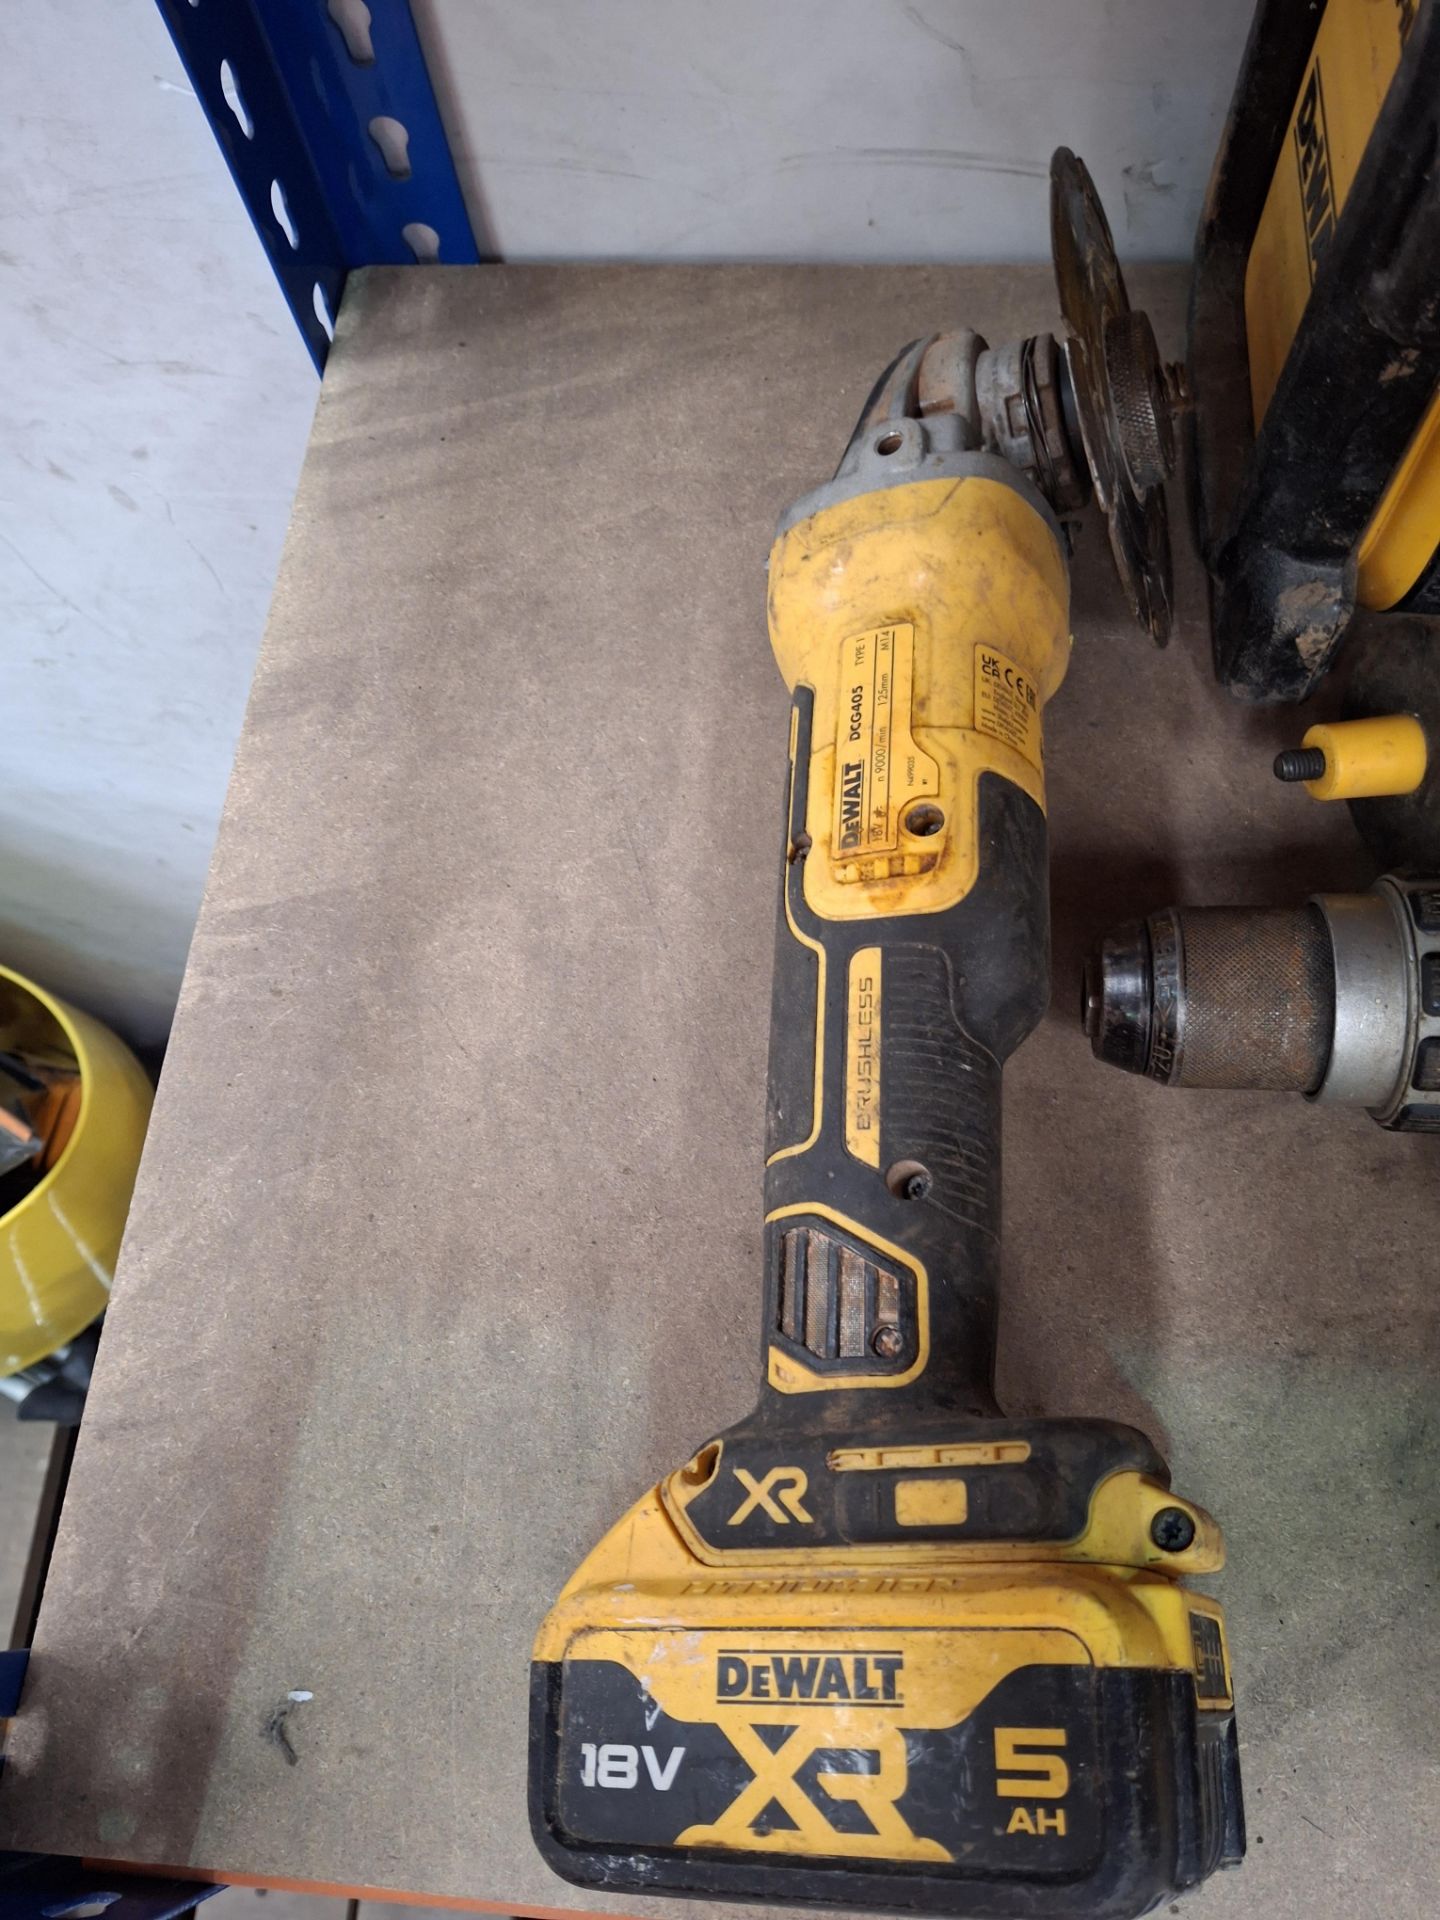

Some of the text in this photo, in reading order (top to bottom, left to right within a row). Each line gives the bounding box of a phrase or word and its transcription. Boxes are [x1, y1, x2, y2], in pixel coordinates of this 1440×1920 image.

[854, 645, 865, 667] TYPE
[880, 630, 891, 651] M14
[849, 685, 863, 741] DCG405
[877, 673, 888, 706] 125mm
[875, 727, 887, 774] 9000/min
[841, 762, 862, 850] DEWALT
[871, 824, 884, 843] 18V
[857, 977, 873, 1131] BRUSHLESS
[727, 1466, 814, 1525] XR
[717, 1655, 903, 1703] DEWALT
[581, 1743, 686, 1791] 18V
[994, 1727, 1070, 1799] 5
[673, 1721, 956, 1863] XR
[1006, 1806, 1067, 1837] AH
